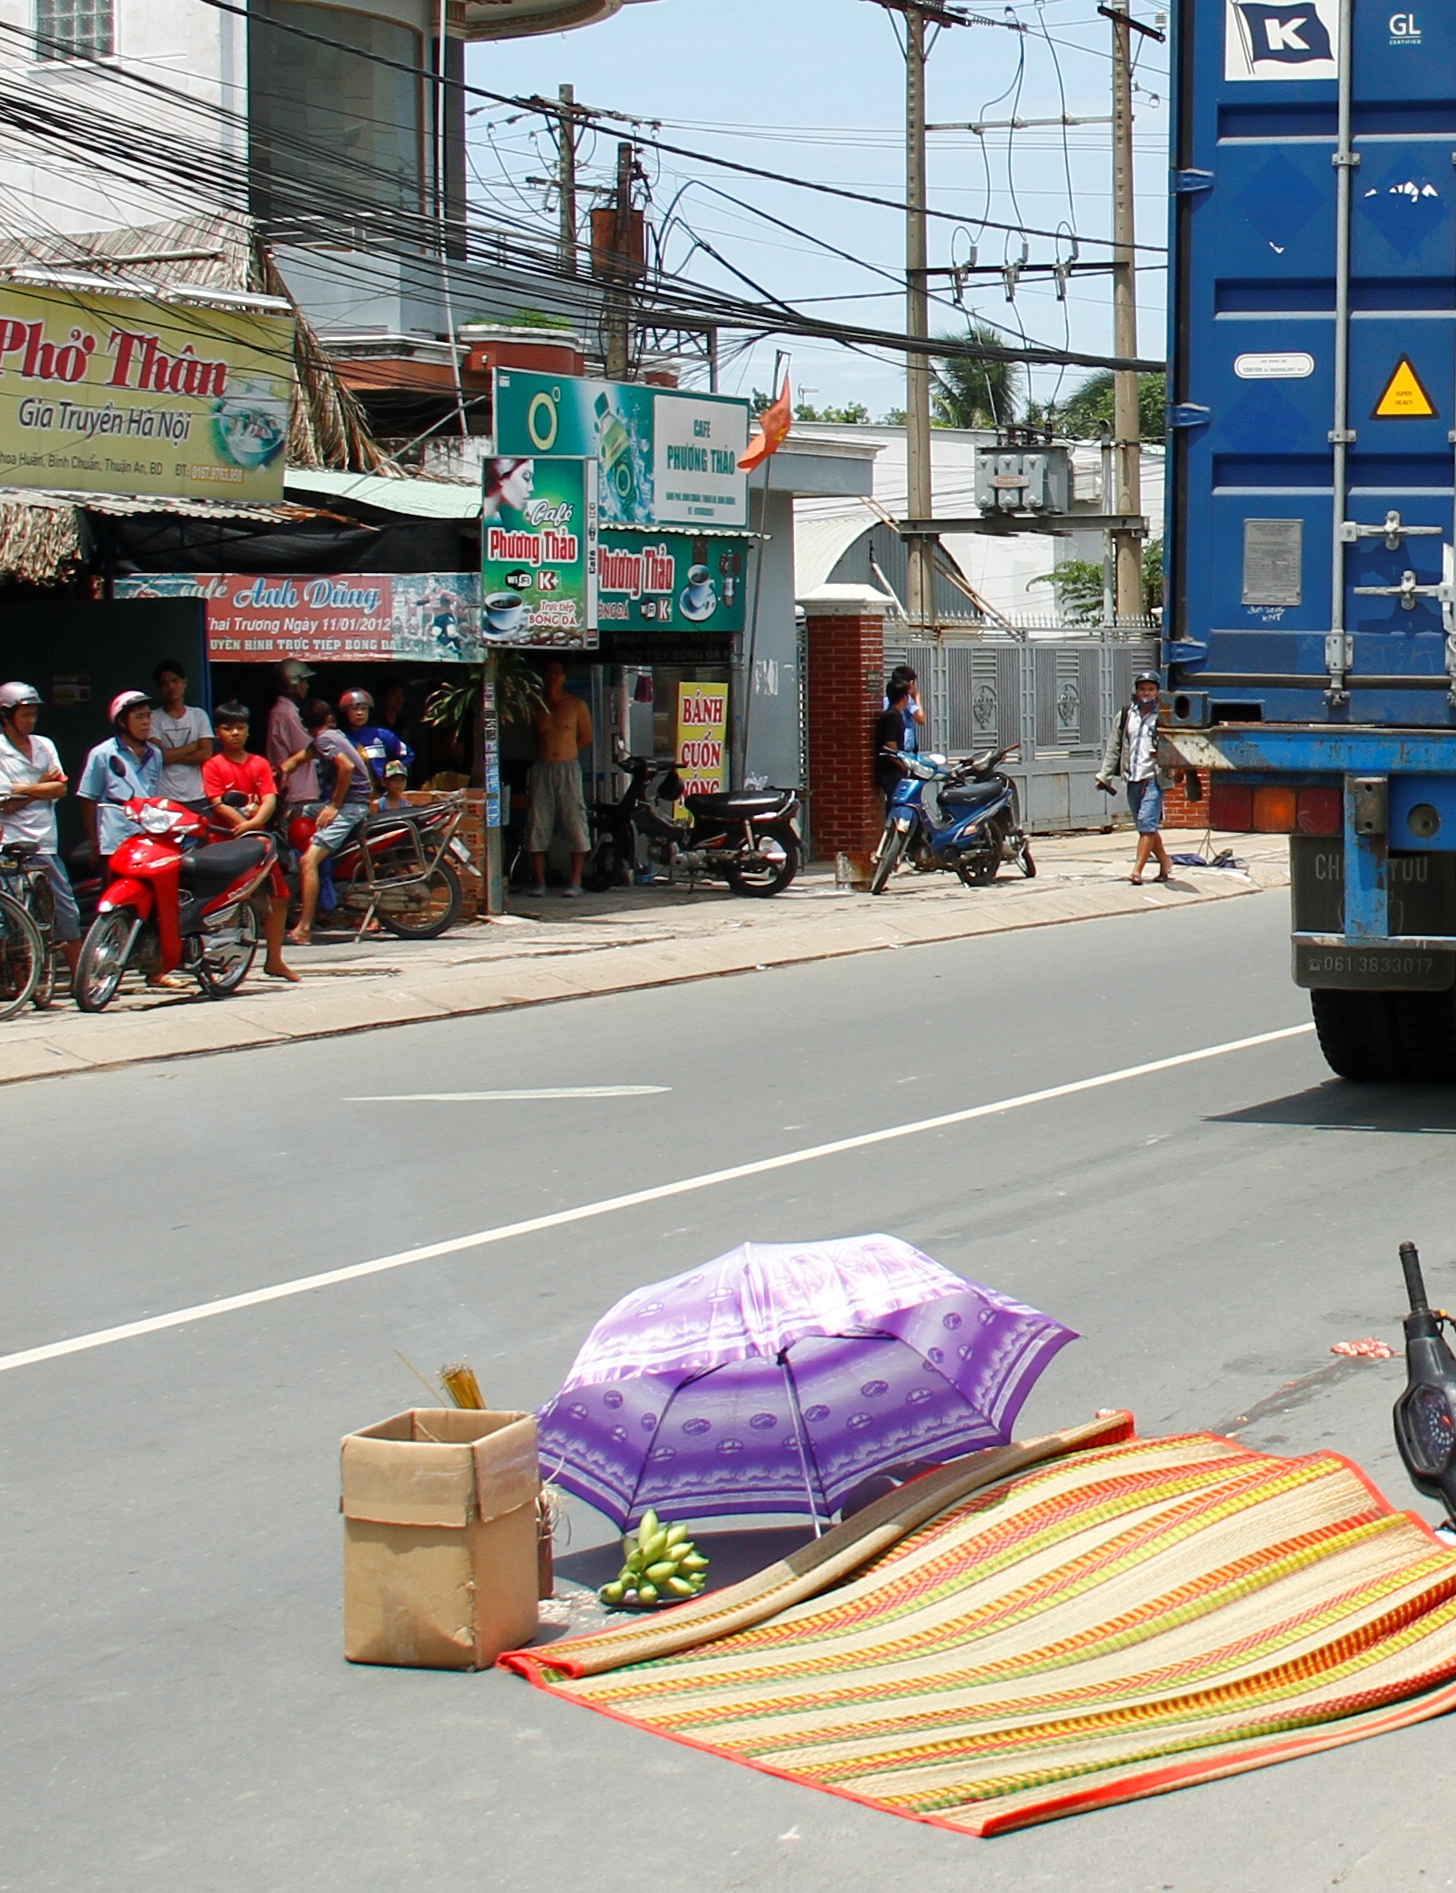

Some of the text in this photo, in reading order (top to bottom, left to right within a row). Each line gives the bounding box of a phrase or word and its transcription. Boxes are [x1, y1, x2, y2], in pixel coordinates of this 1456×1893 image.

[1264, 17, 1310, 51] K
[1389, 13, 1421, 35] GL
[0, 318, 228, 397] Phở Thân
[19, 398, 192, 447] Gia Truyền Hà Nội
[530, 500, 575, 527] Café
[489, 528, 542, 566] Phương
[543, 526, 578, 562] Thảo
[643, 543, 674, 592] Thảo
[179, 576, 383, 615] café Anh Dũng
[208, 616, 230, 631] hai
[283, 617, 318, 635] Ngày
[322, 617, 392, 632] 11/01/2012
[209, 635, 241, 650] UYỀN
[682, 689, 724, 724] BÁNH
[681, 729, 722, 768] CUỐN
